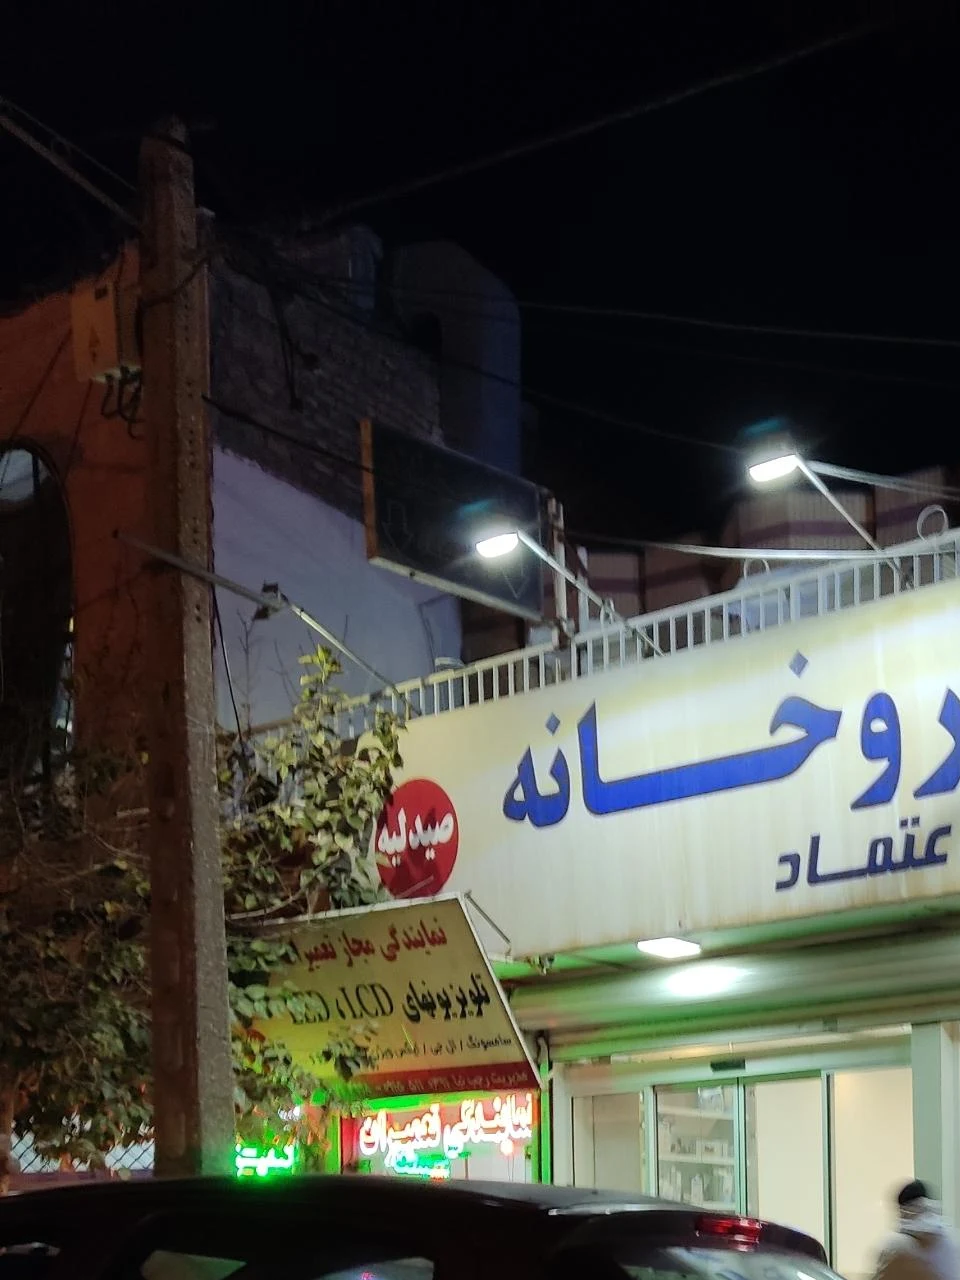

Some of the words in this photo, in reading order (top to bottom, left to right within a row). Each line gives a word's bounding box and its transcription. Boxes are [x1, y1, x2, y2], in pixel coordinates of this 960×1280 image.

[282, 934, 337, 972] تعمیرا
[340, 930, 376, 968] مجاز
[381, 917, 448, 963] نمایندگی
